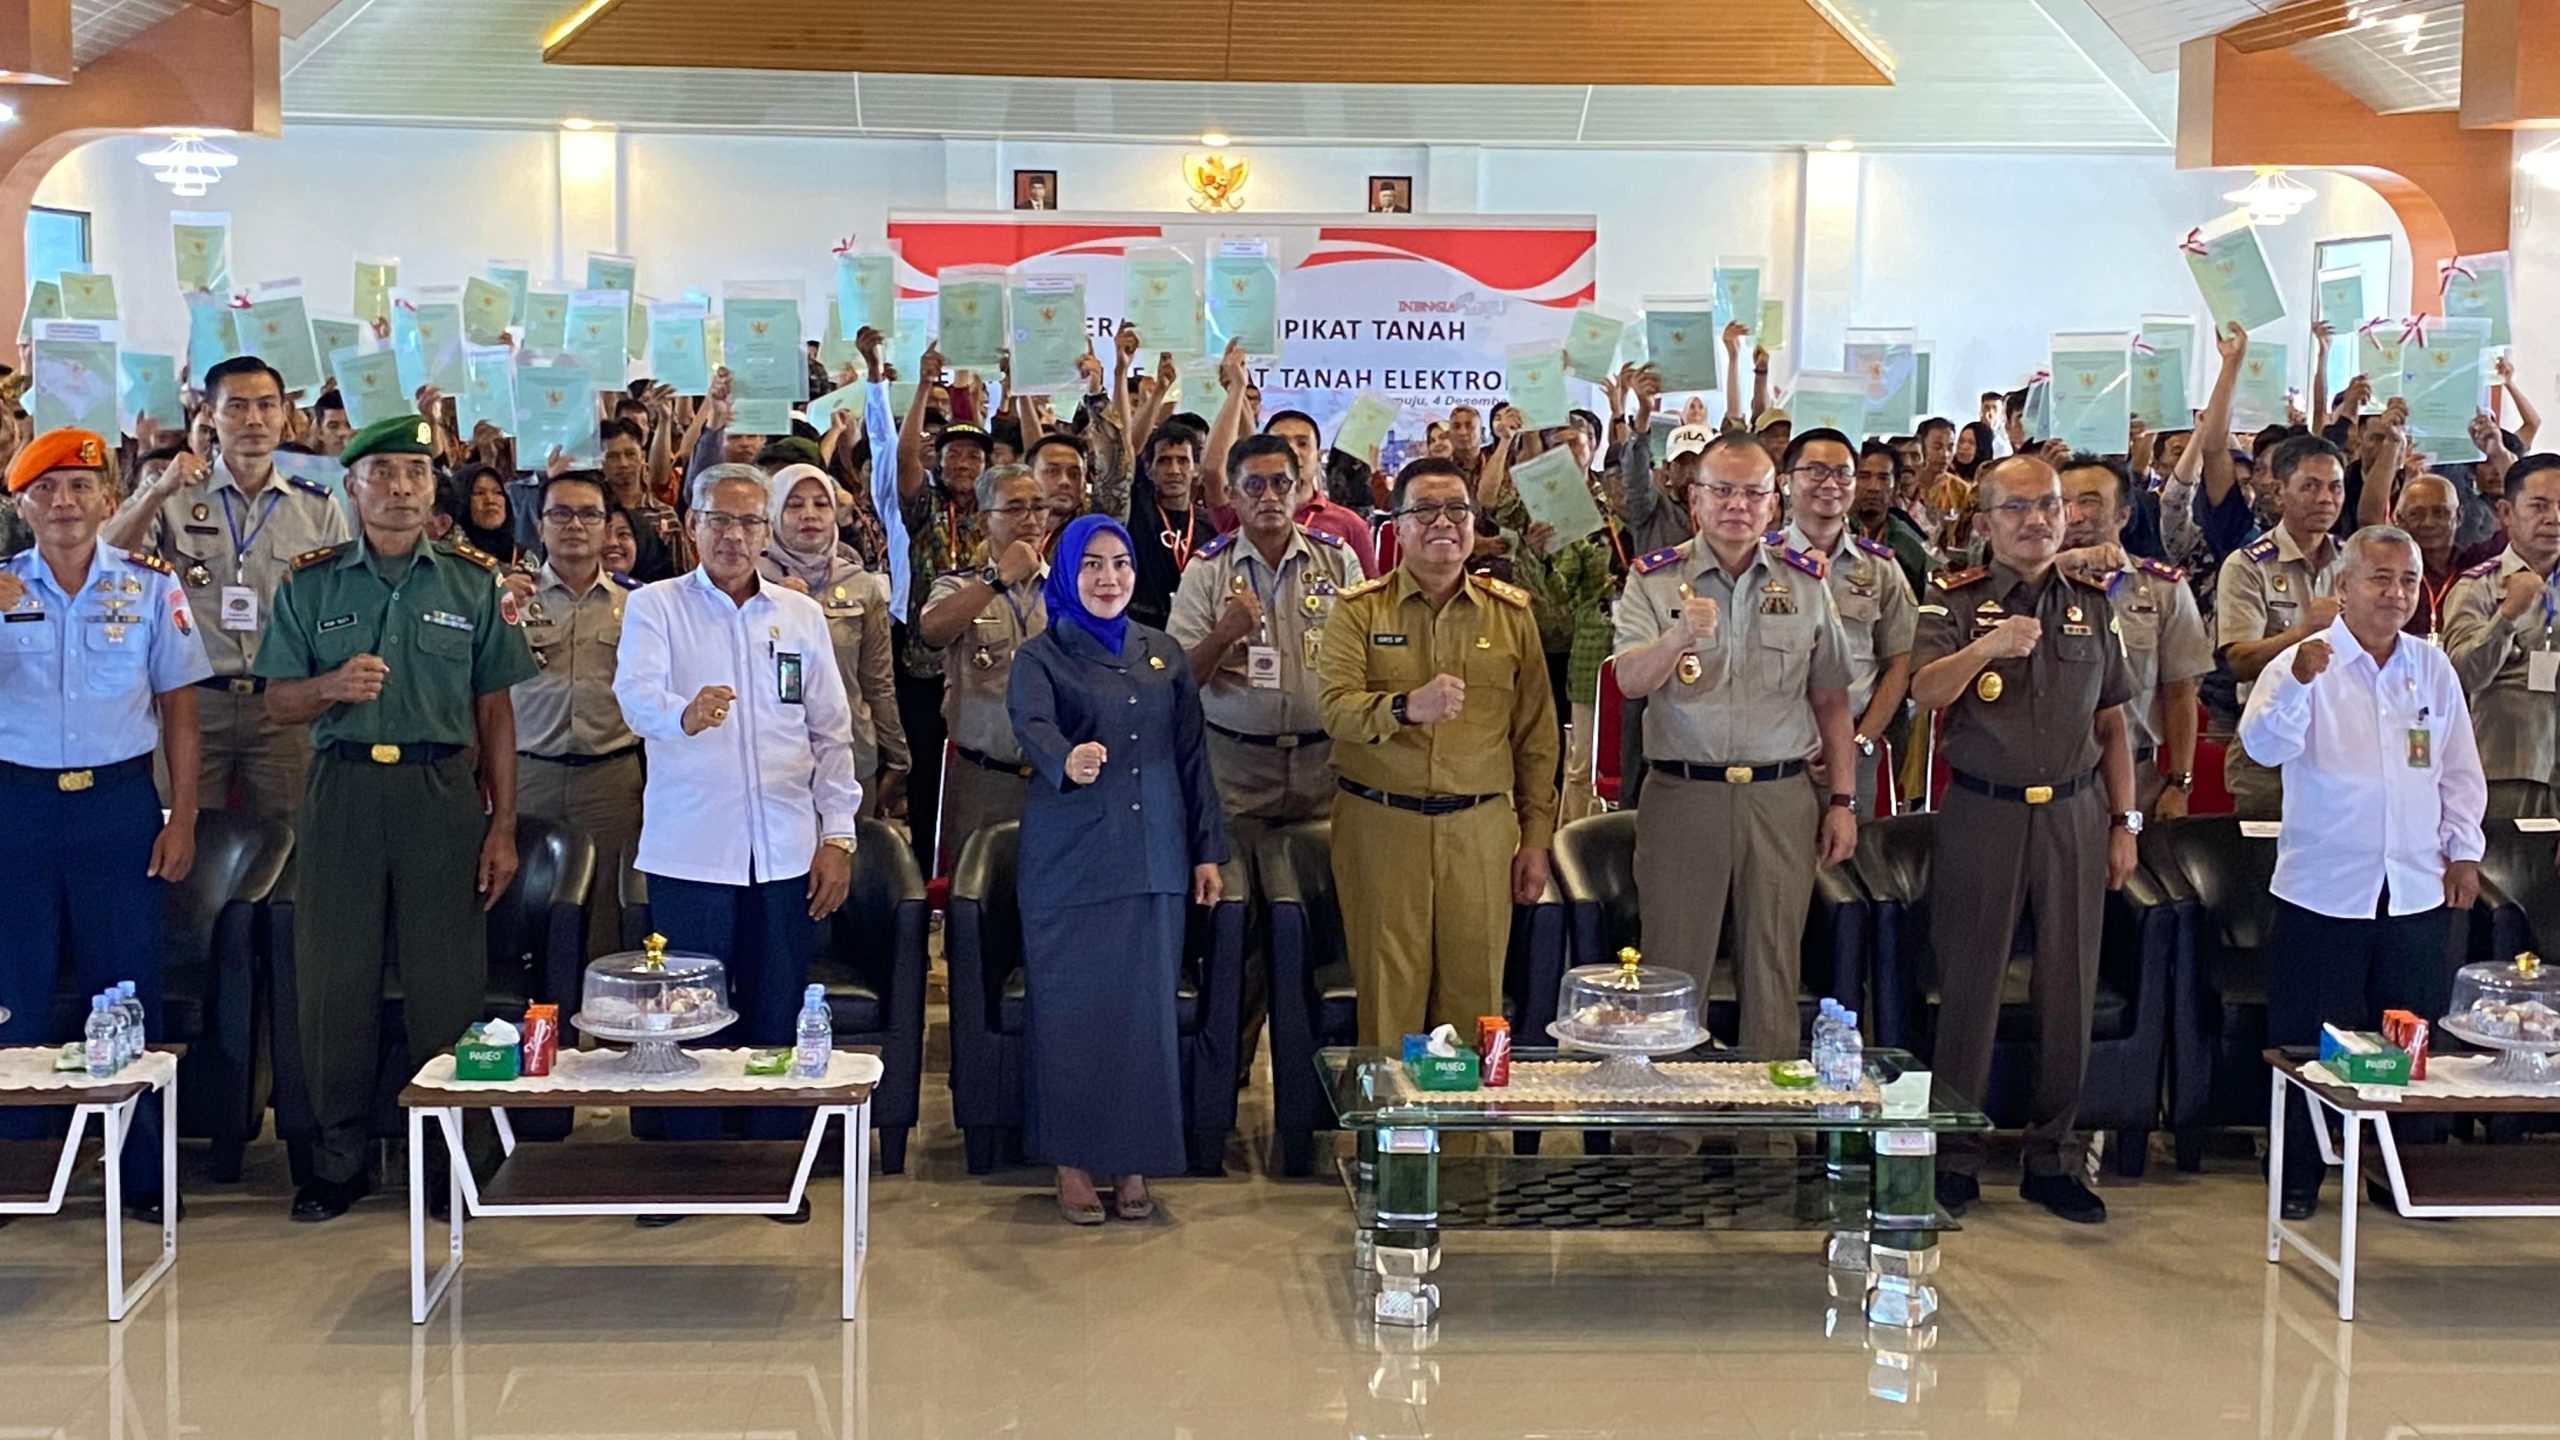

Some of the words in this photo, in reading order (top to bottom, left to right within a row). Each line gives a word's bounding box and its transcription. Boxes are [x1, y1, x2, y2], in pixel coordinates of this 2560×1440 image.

[1371, 320, 1465, 341] TANAH
[1280, 368, 1372, 389] TANAH
[1433, 396, 1440, 405] 4
[1674, 431, 1706, 444] FILA
[469, 1051, 501, 1061] PASEO
[1435, 1061, 1467, 1072] PASEO
[2365, 1059, 2397, 1070] PASEO
